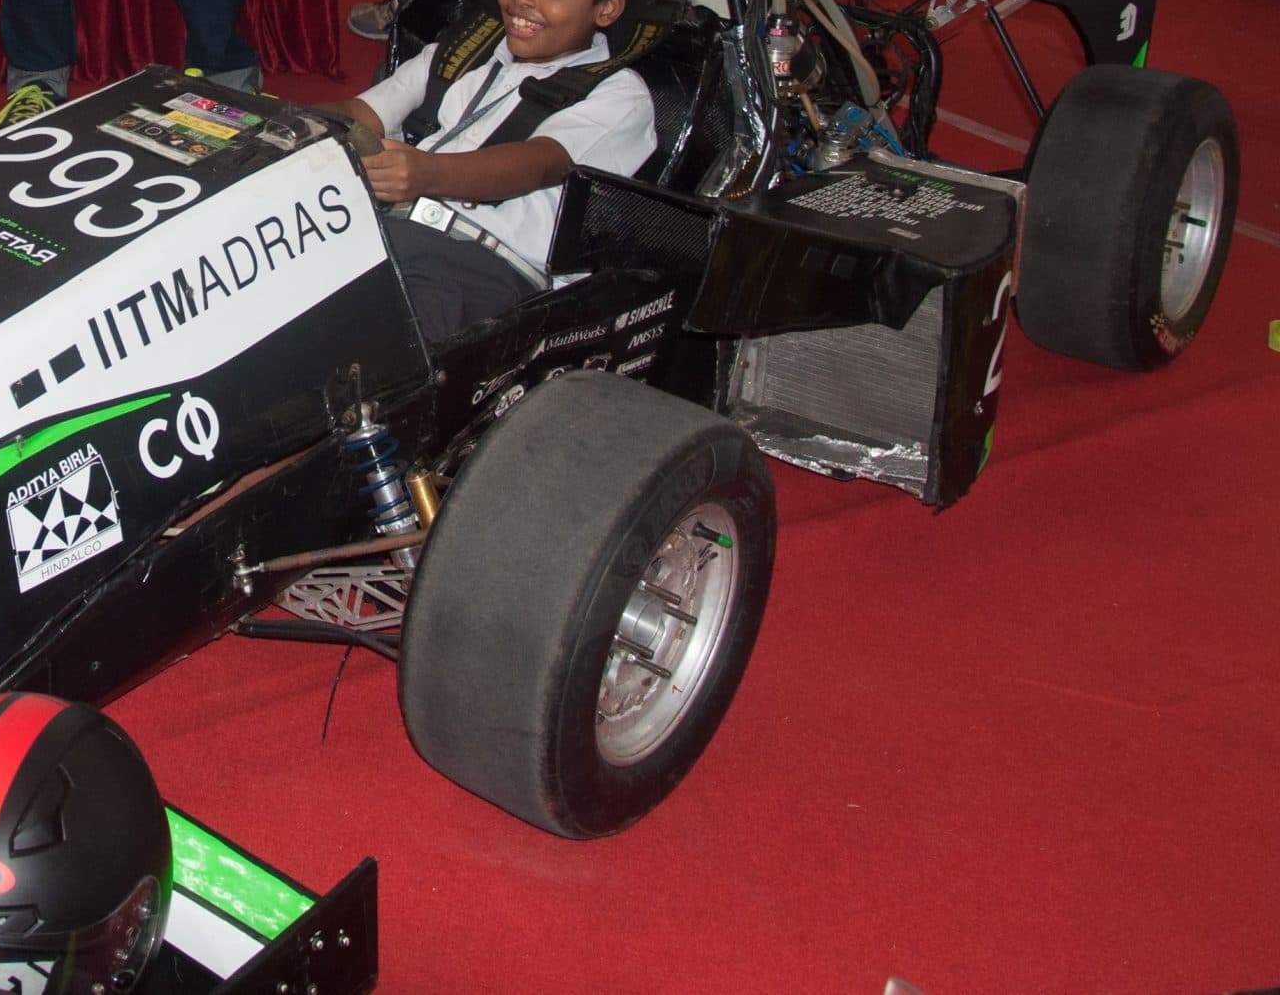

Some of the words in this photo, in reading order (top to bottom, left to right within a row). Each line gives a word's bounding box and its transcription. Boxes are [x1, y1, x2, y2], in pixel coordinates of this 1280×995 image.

[546, 325, 606, 351] MathWorks
[628, 323, 666, 349] ANSYS
[6, 467, 60, 508] ADITYA
[59, 443, 99, 482] BIRLA
[39, 540, 103, 581] HINDALCO
